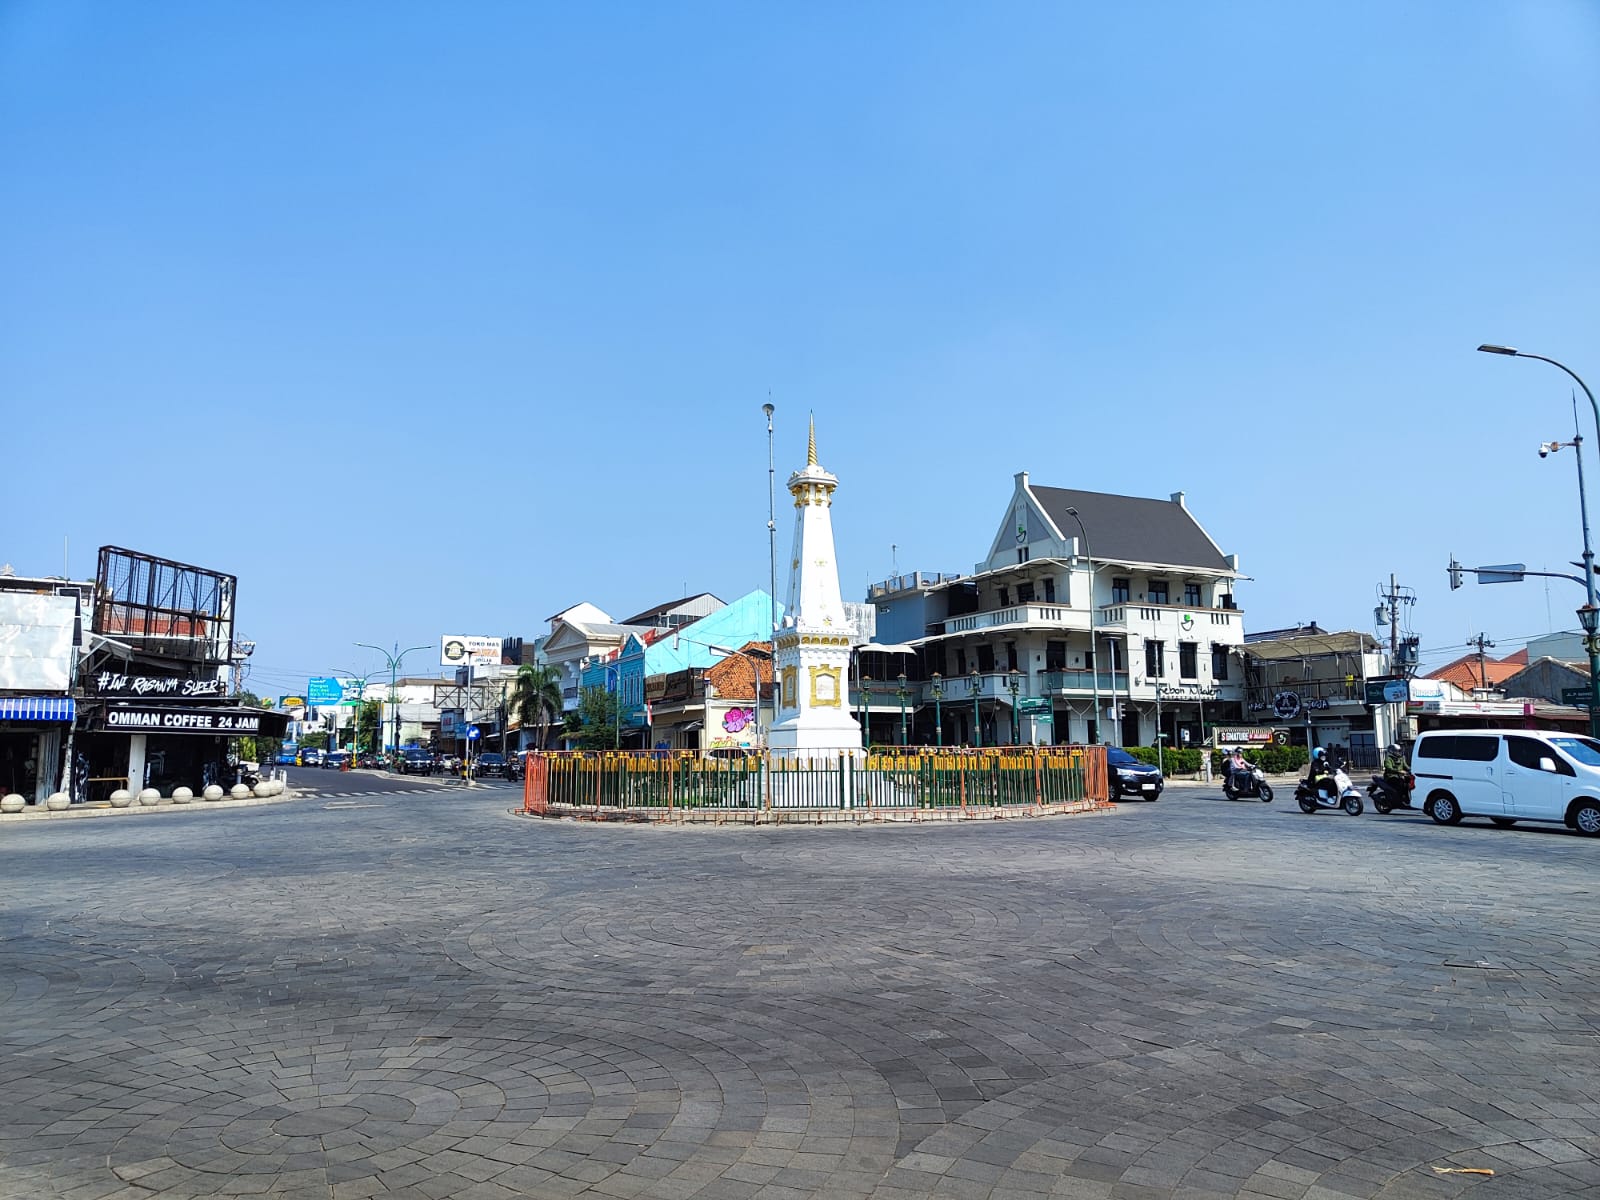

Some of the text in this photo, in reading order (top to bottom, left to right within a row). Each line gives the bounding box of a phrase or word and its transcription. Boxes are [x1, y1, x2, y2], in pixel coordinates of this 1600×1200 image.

[181, 679, 219, 696] SUPER
[108, 711, 259, 729] OMMAN COFFEE 24 JAM
